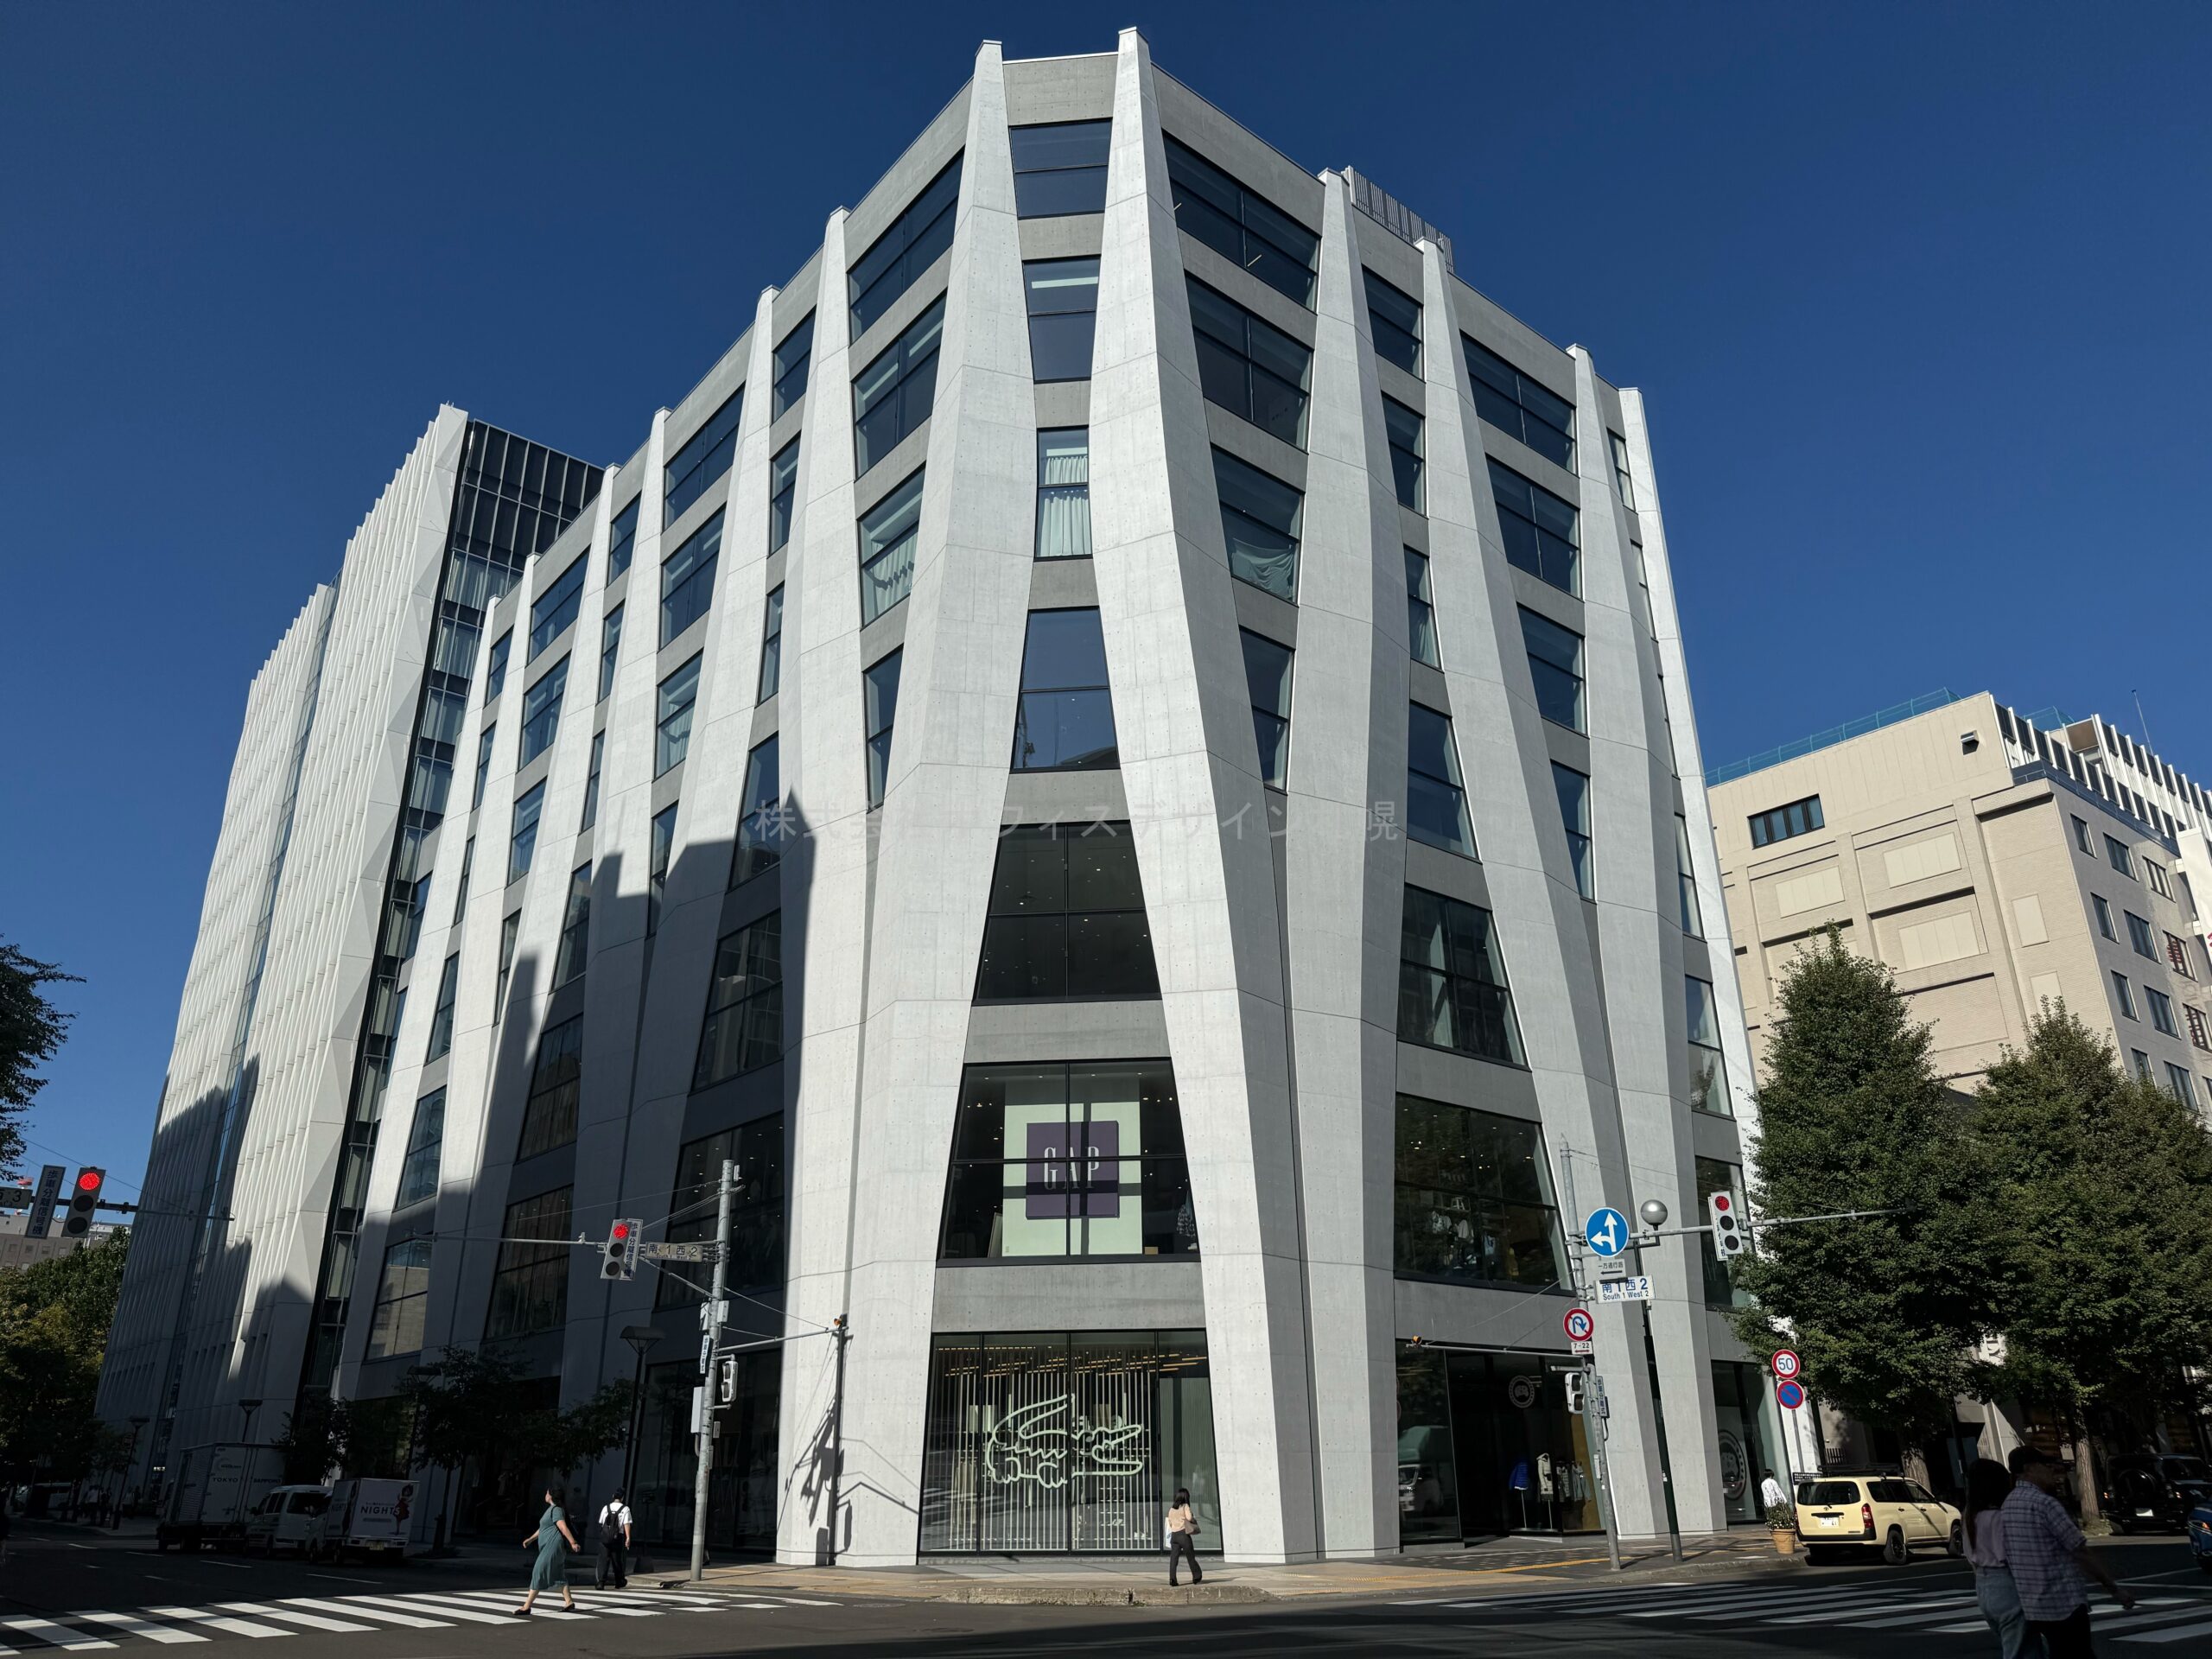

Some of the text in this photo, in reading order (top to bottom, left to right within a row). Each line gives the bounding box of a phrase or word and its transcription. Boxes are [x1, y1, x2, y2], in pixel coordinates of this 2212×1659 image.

[1043, 1145, 1100, 1191] GAP
[1603, 1293, 1621, 1301] South
[1627, 1290, 1643, 1299] West
[1778, 1358, 1794, 1370] 50
[360, 1506, 401, 1516] NIGHTS
